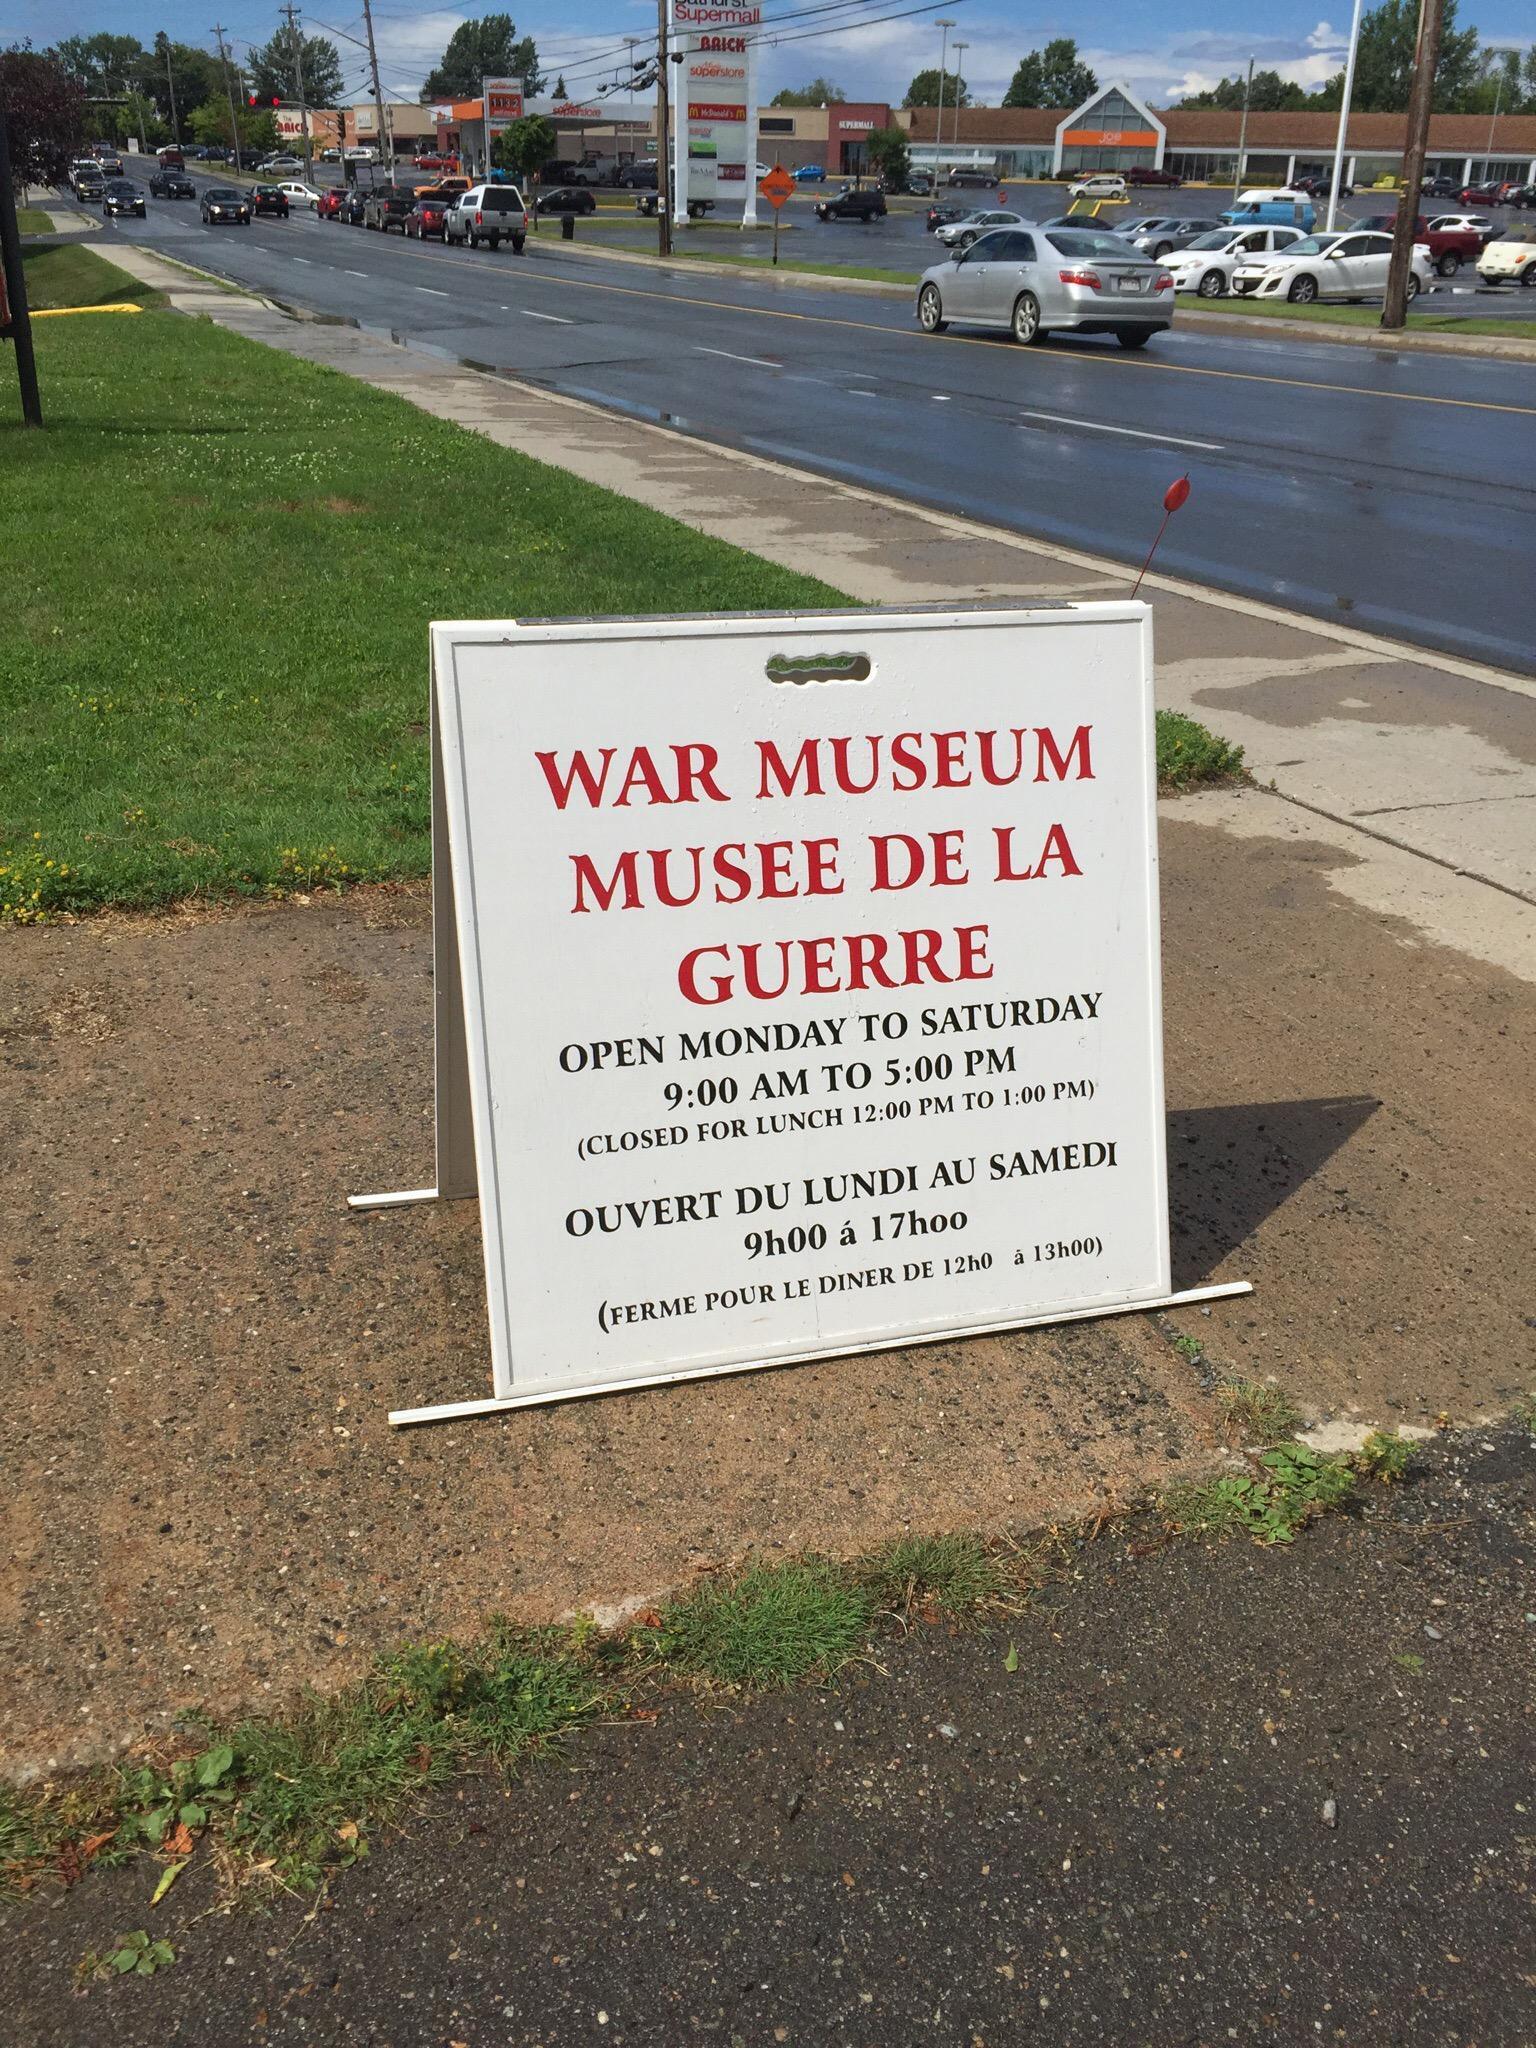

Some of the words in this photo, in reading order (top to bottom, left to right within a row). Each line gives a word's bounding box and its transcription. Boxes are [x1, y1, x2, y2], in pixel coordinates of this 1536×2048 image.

[675, 4, 760, 24] Supermall
[700, 36, 746, 53] BRICK
[690, 66, 745, 78] superstore
[701, 109, 734, 118] McDonald's
[839, 120, 874, 130] SUPERMALL
[535, 744, 731, 810] WAR
[755, 725, 1096, 800] MUSEUM
[569, 838, 845, 914] MUSEE
[869, 829, 969, 893] DE
[992, 823, 1084, 882] LA
[677, 924, 994, 1006] GUERRE
[559, 1036, 665, 1073] OPEN
[679, 1017, 848, 1061] MONDAY
[859, 1012, 908, 1042] TO
[921, 992, 1103, 1036] SATURDAY
[664, 1076, 738, 1112] 9:00
[750, 1068, 810, 1101] AM
[822, 1062, 872, 1093] TO
[885, 1053, 953, 1086] 5:00
[964, 1046, 1017, 1077] PM
[577, 1125, 689, 1162] (CLOSED
[697, 1118, 749, 1142] FOR
[757, 1107, 843, 1135] LUNCH
[853, 1100, 912, 1124] 12:00
[919, 1095, 954, 1116] PM
[962, 1090, 994, 1111] TO
[1003, 1084, 1046, 1107] 1:00
[1053, 1079, 1095, 1100] PM)
[565, 1190, 723, 1237] OUVERT
[735, 1182, 791, 1215] DU
[803, 1165, 919, 1206] LUNDI
[929, 1157, 976, 1189] AU
[989, 1141, 1118, 1181] SAMEDI
[744, 1223, 827, 1260] 9h00
[839, 1219, 858, 1247] á
[872, 1209, 968, 1242] 17hoo
[598, 1295, 697, 1334] (FERME
[705, 1284, 777, 1312] POUR
[783, 1278, 811, 1300] LE
[818, 1266, 896, 1294] DINER
[902, 1260, 934, 1282] DE
[943, 1252, 993, 1276] 12h0
[1034, 1236, 1103, 1263] 13h00)
